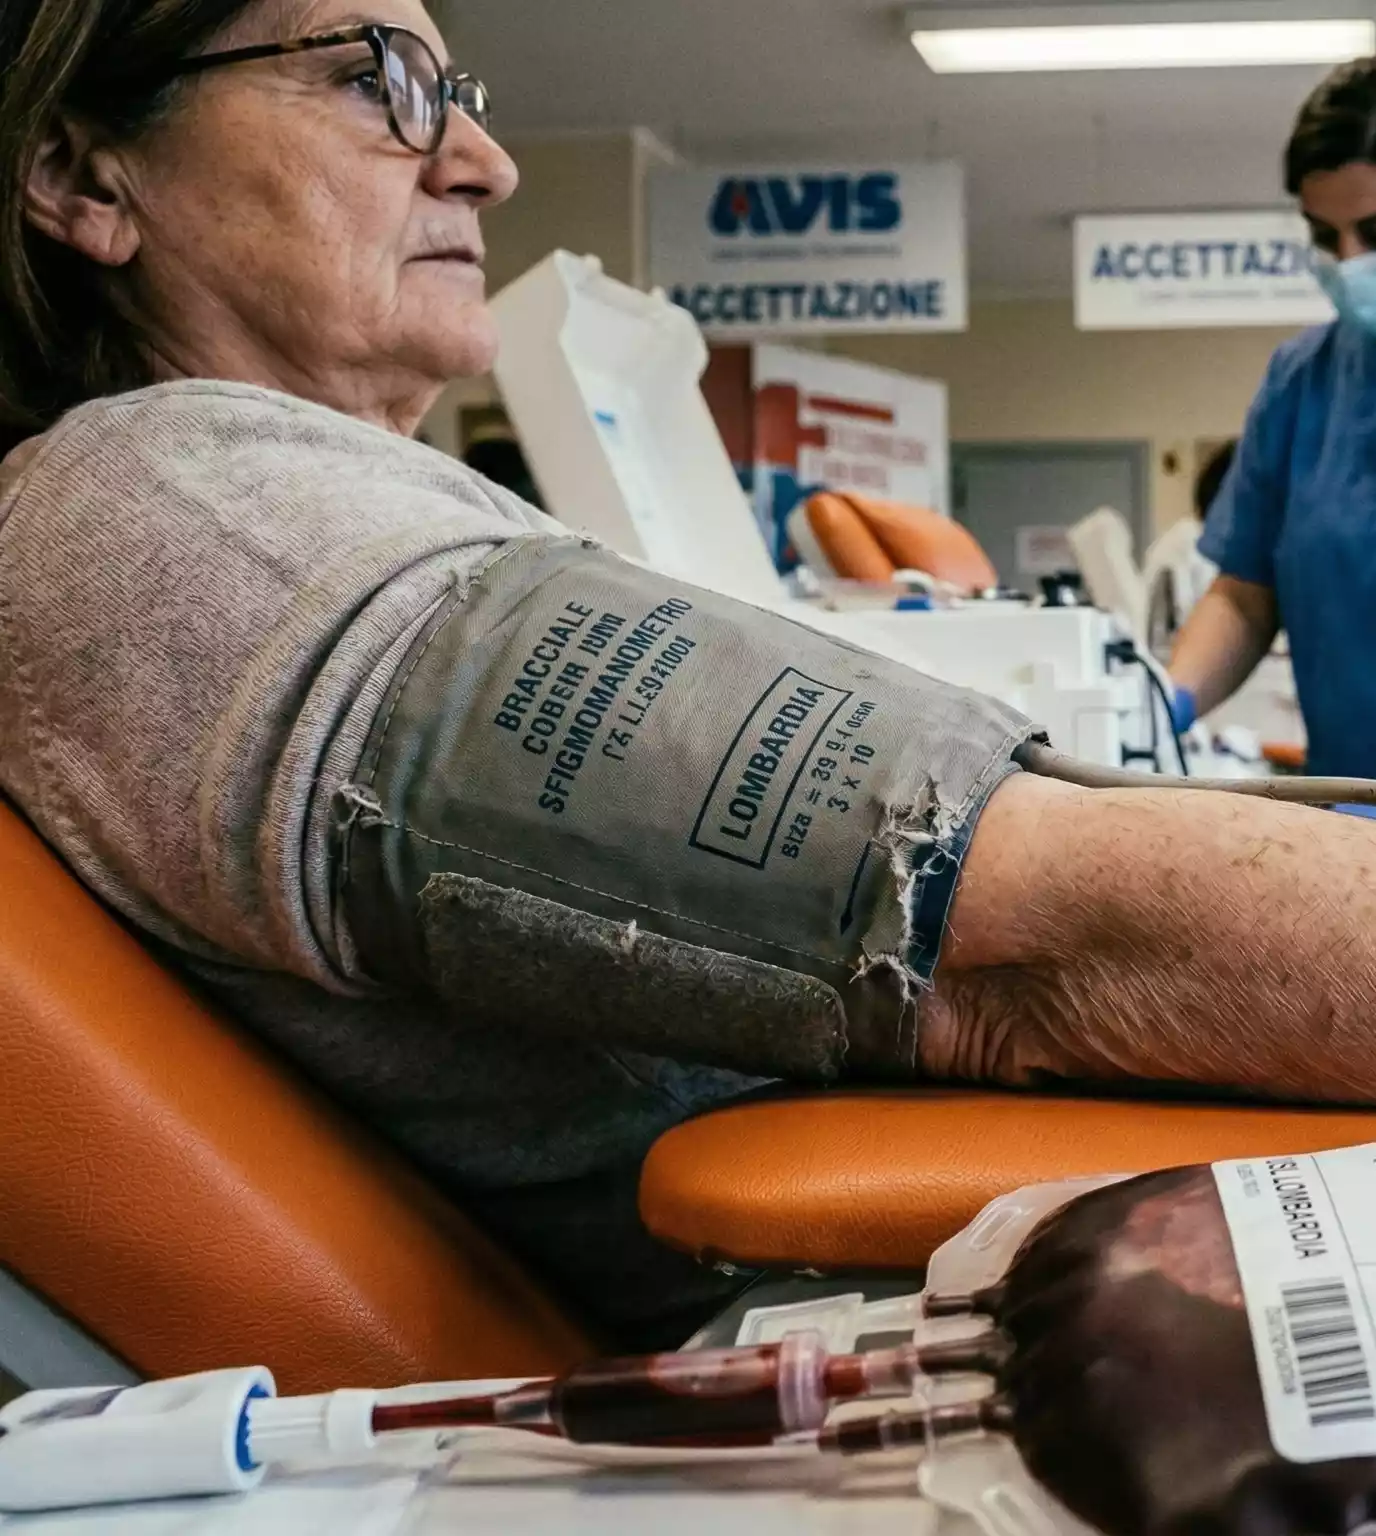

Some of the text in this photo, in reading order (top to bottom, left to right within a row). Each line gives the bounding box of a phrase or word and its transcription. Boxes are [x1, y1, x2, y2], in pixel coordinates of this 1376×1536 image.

[708, 172, 903, 236] AVIS
[494, 601, 594, 732] BRACCIALE
[538, 597, 693, 814] SFIGMOMANOMETRO
[720, 687, 825, 840] LOMBARDIA
[827, 796, 852, 814] 3
[850, 744, 875, 765] 10
[1273, 1176, 1328, 1260] LOMBARDIA
